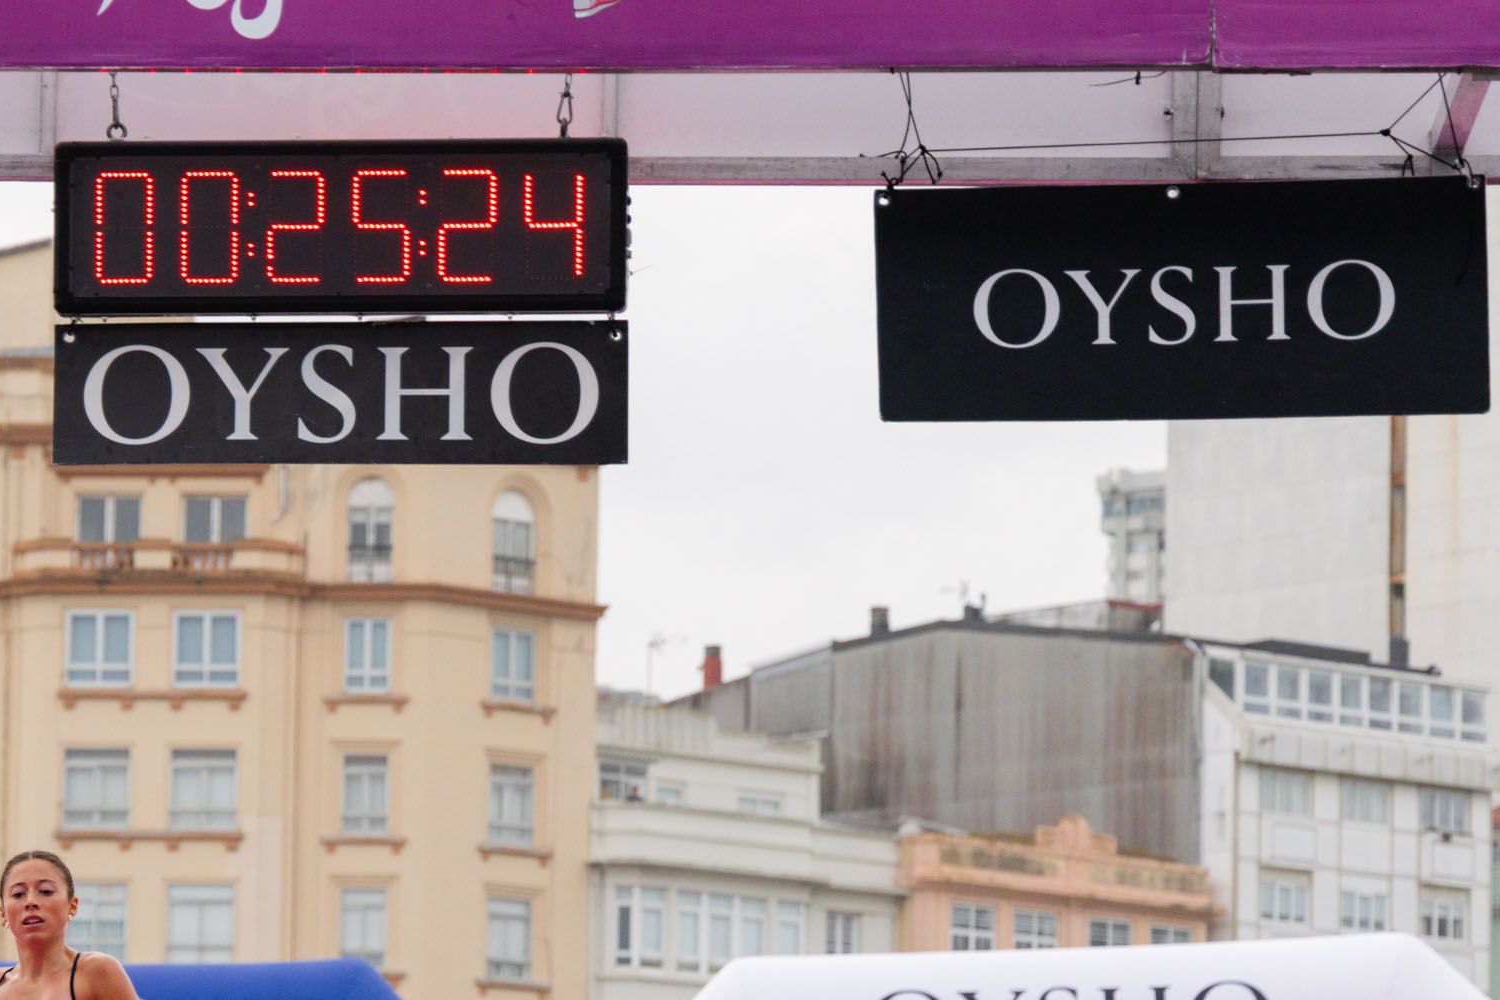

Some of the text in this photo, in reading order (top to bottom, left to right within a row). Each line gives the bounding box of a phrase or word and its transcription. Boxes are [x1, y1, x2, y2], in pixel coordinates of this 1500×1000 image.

[94, 168, 586, 285] 00:25:24
[972, 258, 1397, 349] OYSHO
[82, 341, 600, 445] OYSHO
